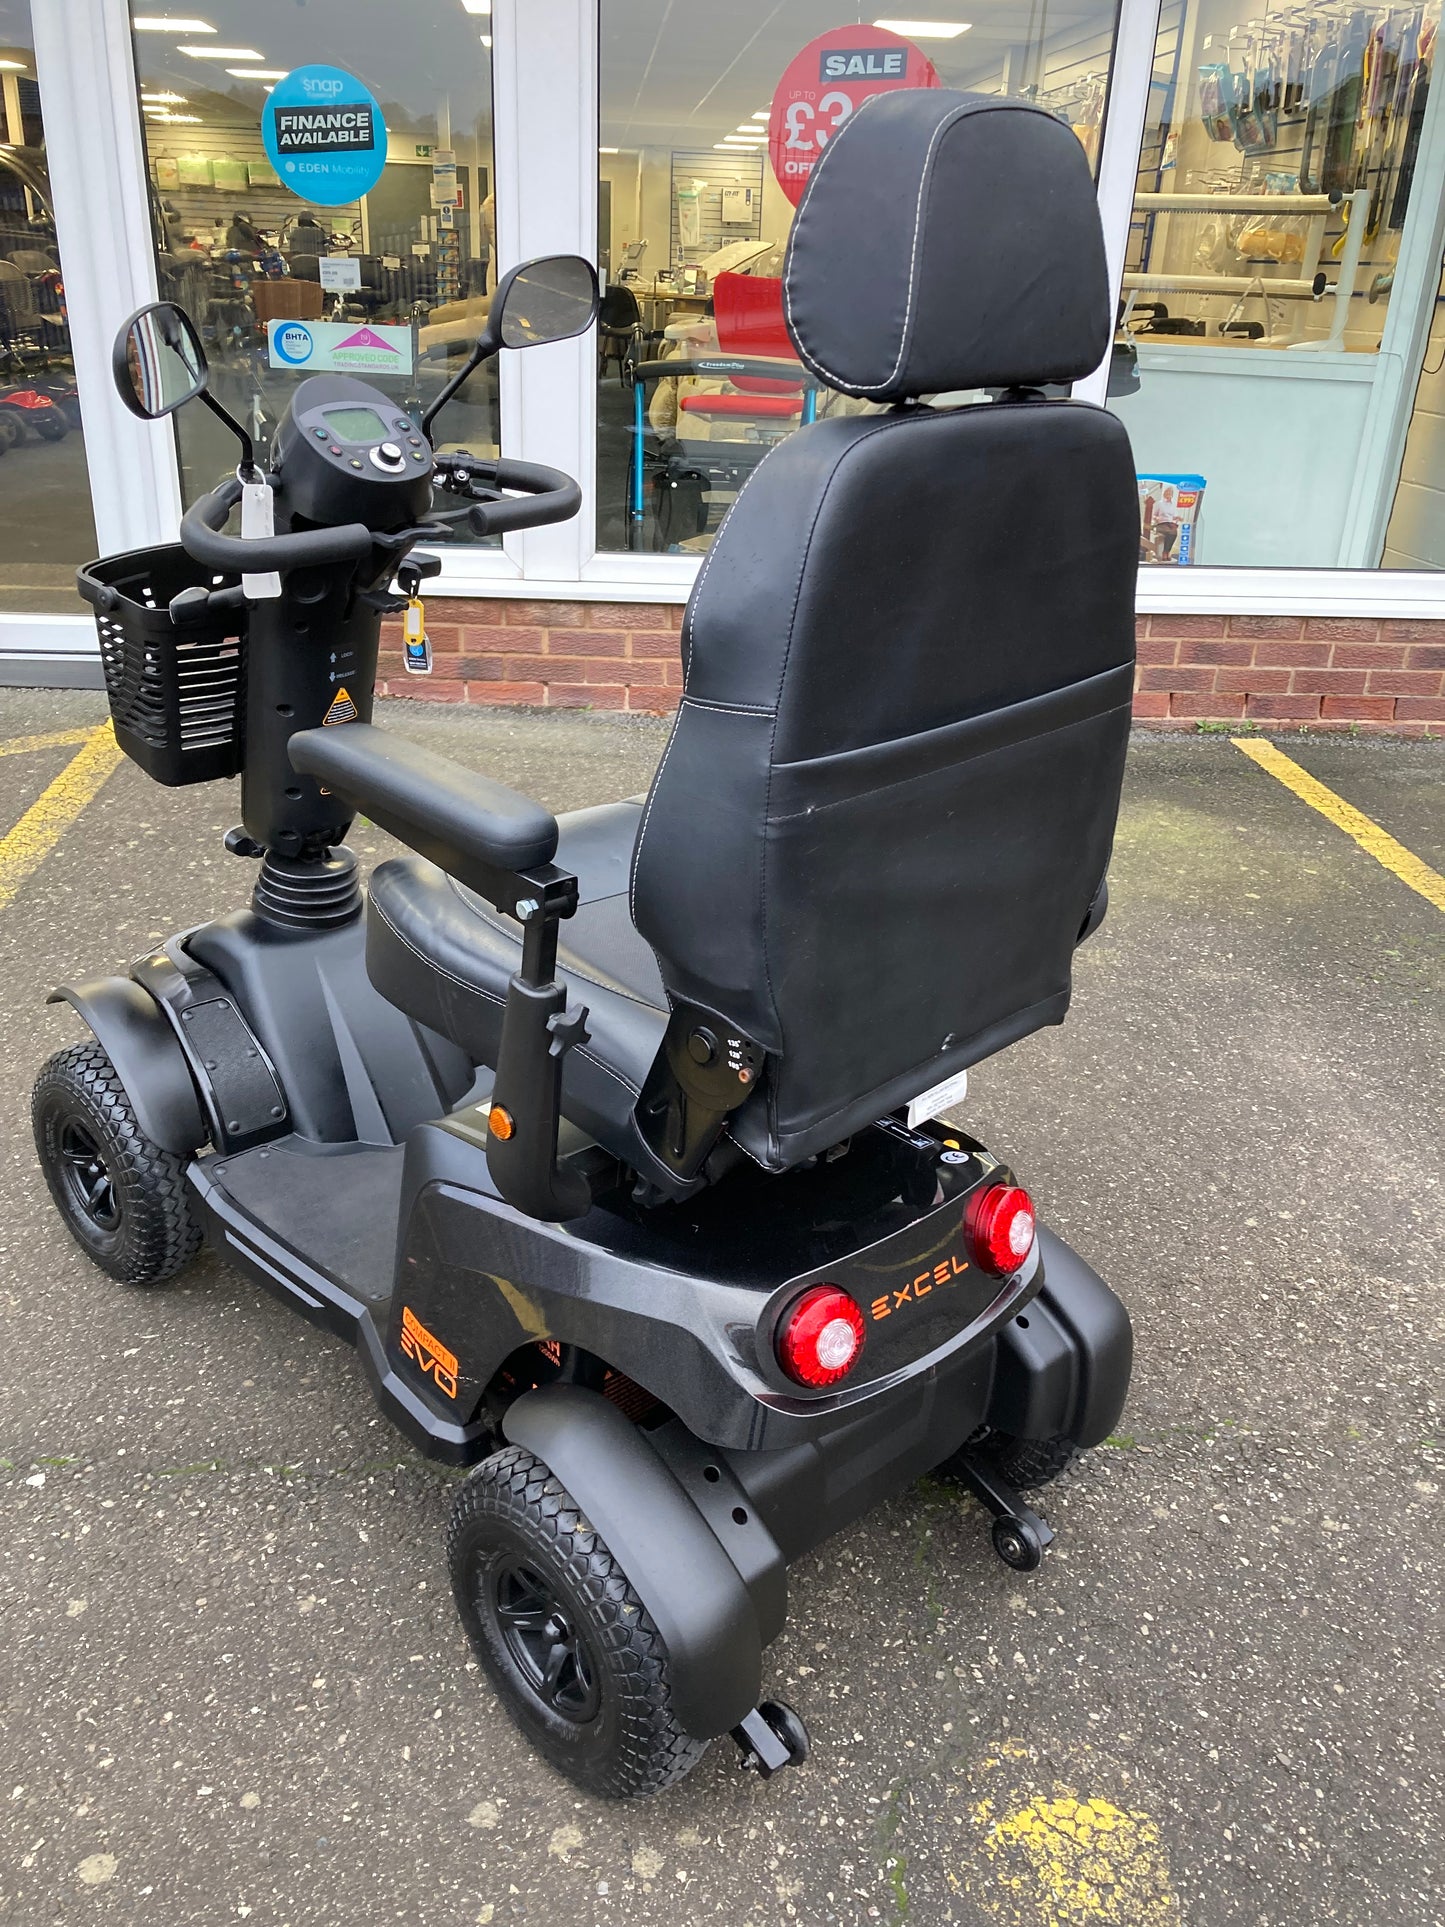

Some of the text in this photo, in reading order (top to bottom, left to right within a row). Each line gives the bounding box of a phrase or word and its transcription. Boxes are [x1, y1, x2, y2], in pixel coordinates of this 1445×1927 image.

[825, 53, 903, 76] SALE
[303, 78, 344, 97] snap
[788, 90, 816, 100] UP TO
[280, 112, 369, 131] FINANCE
[280, 130, 370, 145] AVAILABLE
[298, 163, 370, 177] EDEN Mobility
[285, 332, 309, 342] BHTA
[332, 351, 400, 364] APPROVED CODE
[871, 1255, 969, 1321] EXCEL
[405, 1312, 448, 1362] COMPACT
[400, 1327, 458, 1399] EVO
